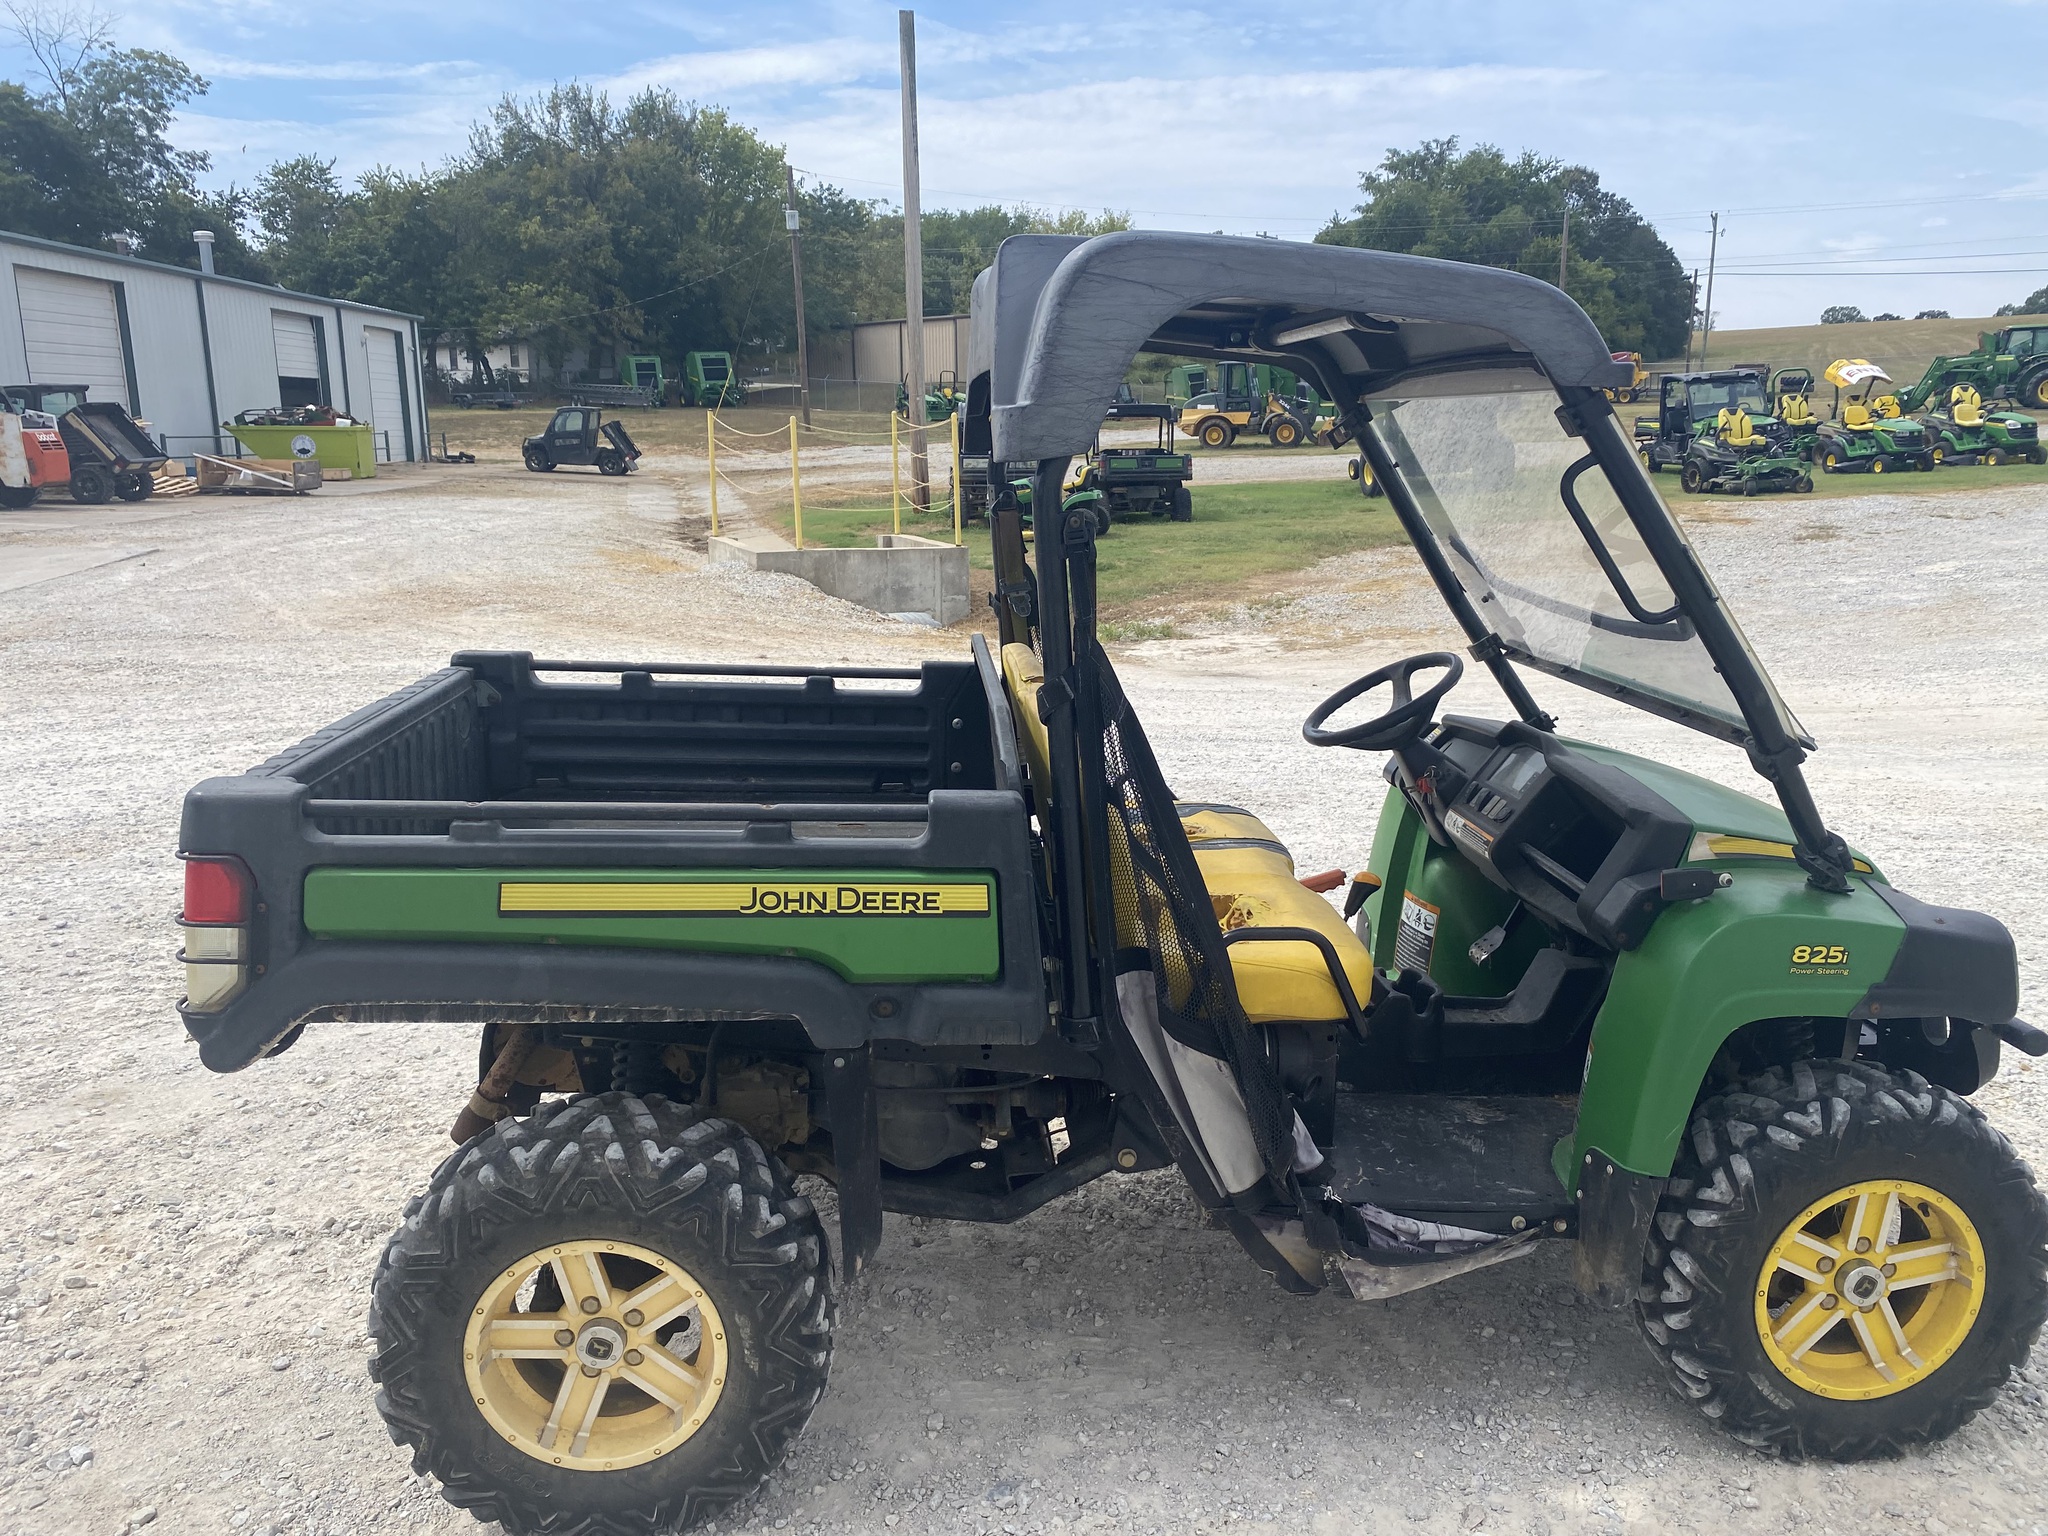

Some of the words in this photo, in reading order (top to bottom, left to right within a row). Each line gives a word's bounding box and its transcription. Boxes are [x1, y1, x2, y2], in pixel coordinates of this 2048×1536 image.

[739, 886, 828, 912] JOHN
[836, 886, 941, 912] DEERE
[1792, 945, 1849, 964] 825i
[1789, 967, 1815, 975] Power
[1816, 967, 1850, 976] Steering
